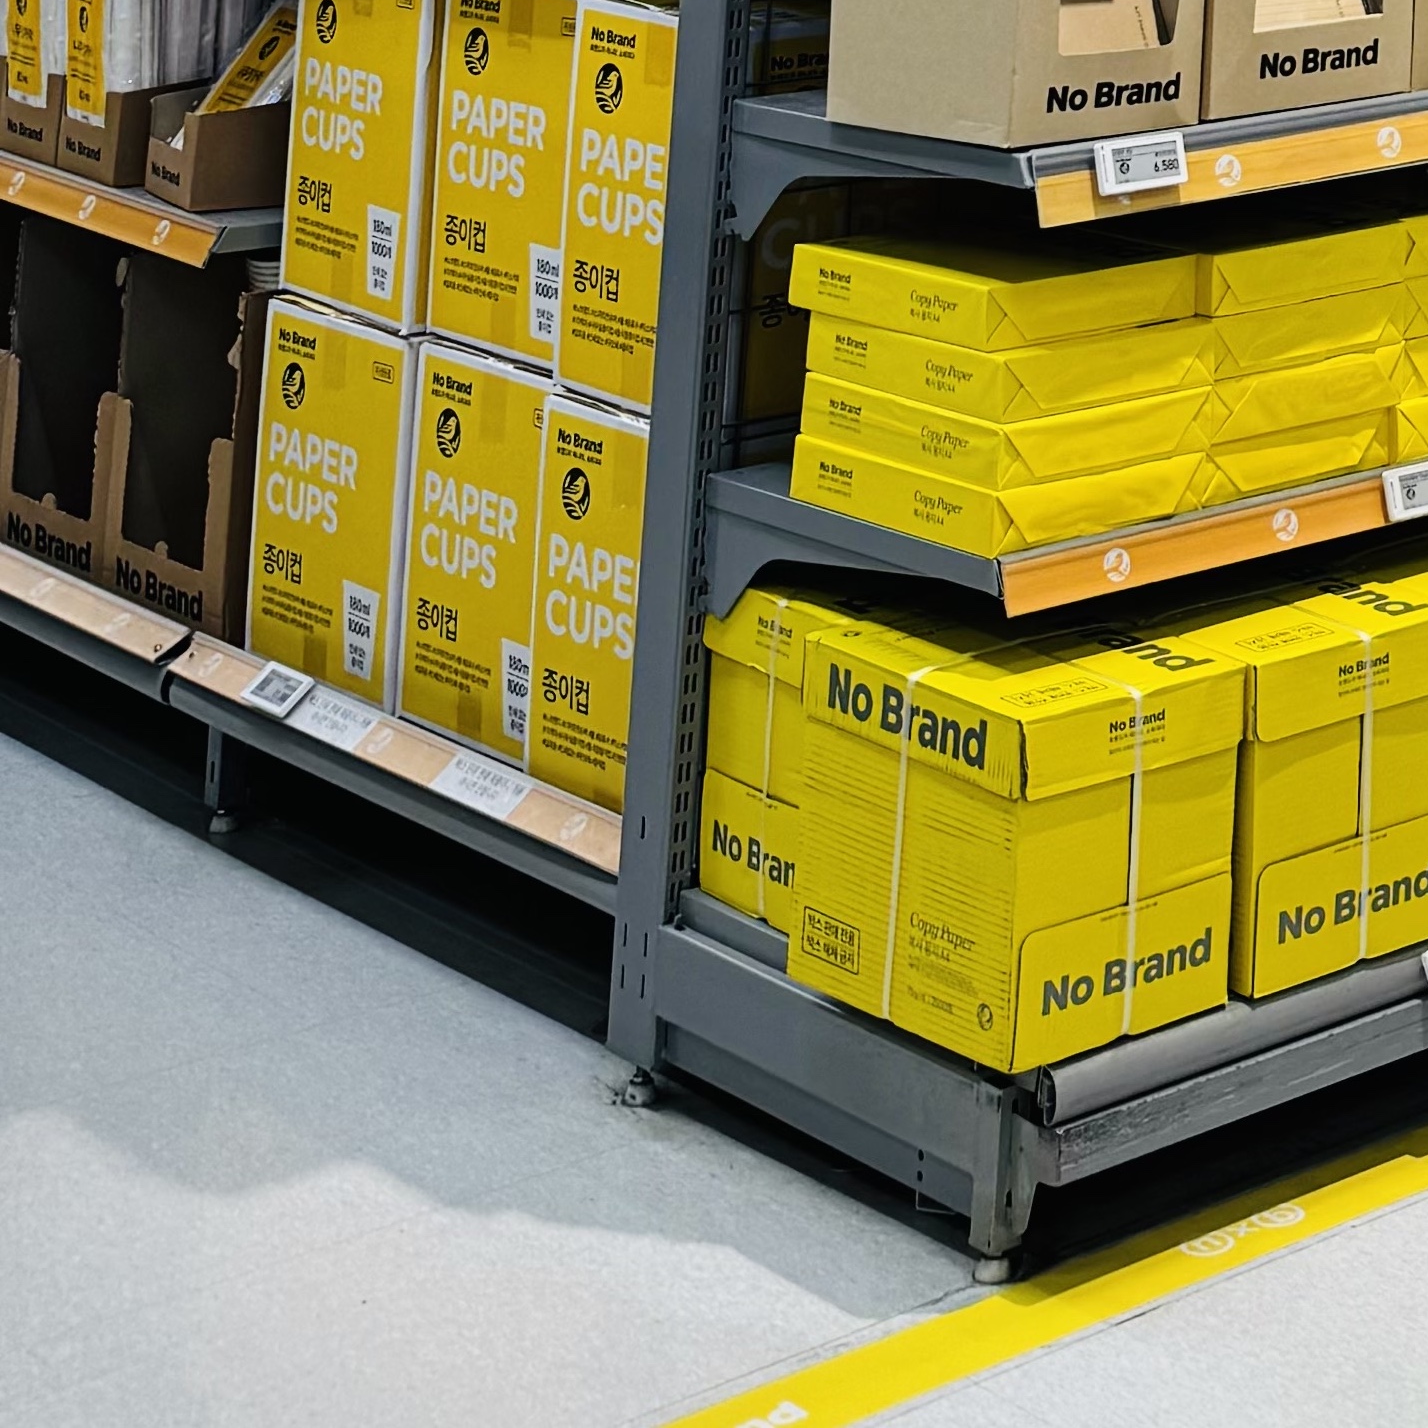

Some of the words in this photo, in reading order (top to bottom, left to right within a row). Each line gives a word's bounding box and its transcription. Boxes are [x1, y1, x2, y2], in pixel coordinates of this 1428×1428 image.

[305, 57, 383, 116] PAPER
[1259, 51, 1297, 80] No
[1301, 38, 1379, 74] Brand
[451, 89, 547, 151] PAPER
[1046, 86, 1088, 114] No
[1094, 71, 1181, 108] Brand
[302, 107, 365, 161] CUPS
[580, 128, 665, 191] PAPE
[297, 176, 333, 213] 종이컵
[447, 142, 525, 198] CUPS
[444, 215, 487, 253] 종이컵
[576, 183, 665, 246] CUPS
[573, 259, 620, 302] 종이컵
[268, 422, 358, 492] PAPER
[265, 472, 338, 535] CUPS
[424, 470, 518, 543] PAPER
[262, 543, 302, 585] 종이컵
[419, 523, 497, 590] CUPS
[416, 597, 458, 642] 종이컵
[545, 589, 634, 660] CUPS
[542, 668, 591, 716] 종이컵
[827, 663, 873, 722] No
[880, 683, 988, 770] Brand
[712, 819, 742, 862] No
[748, 826, 795, 889] Bran
[909, 911, 939, 941] Copy
[940, 922, 976, 952] Paper
[1278, 903, 1325, 945] No
[1041, 975, 1094, 1017] No
[1103, 927, 1212, 996] Brand
